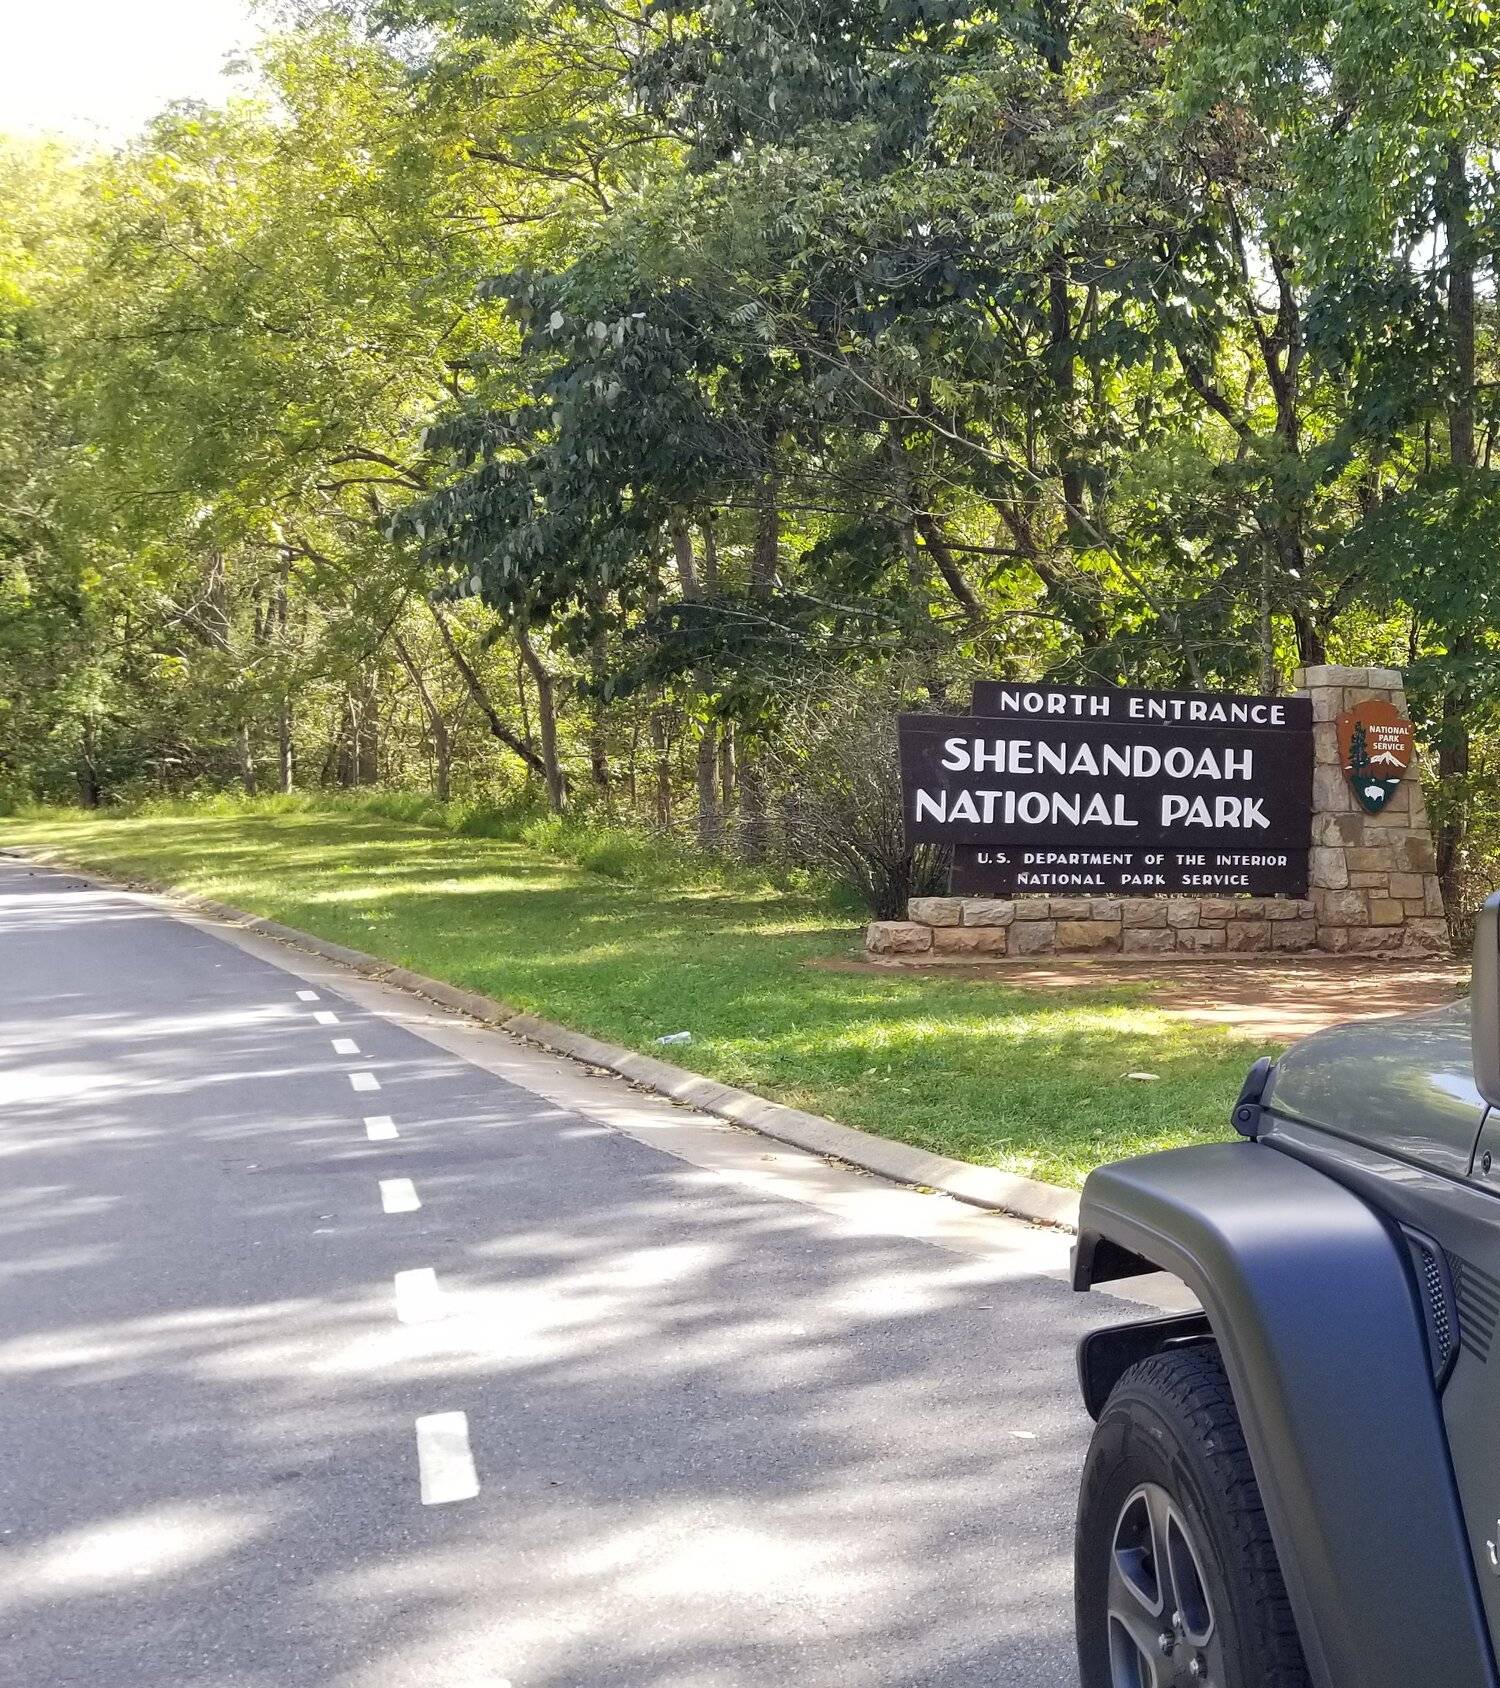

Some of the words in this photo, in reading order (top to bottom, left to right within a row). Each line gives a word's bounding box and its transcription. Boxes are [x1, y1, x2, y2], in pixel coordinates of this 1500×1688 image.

[1000, 691, 1110, 716] NORTH
[1129, 697, 1286, 725] ENTRANCE
[1369, 725, 1409, 735] NATIONAL
[1378, 734, 1399, 742] PARK
[1373, 742, 1405, 751] SERVICE
[941, 737, 1253, 781] SHENANDOAH
[915, 789, 1139, 827] NATIONAL
[1161, 795, 1271, 829] PARK
[1023, 853, 1133, 865] DEPARTMENT
[1144, 854, 1165, 865] OF
[1175, 855, 1206, 866] THE
[1216, 855, 1287, 866] INTERIOR
[1017, 873, 1106, 885] NATIONAL
[1121, 874, 1166, 885] PARK
[1181, 874, 1250, 886] SERVICE
